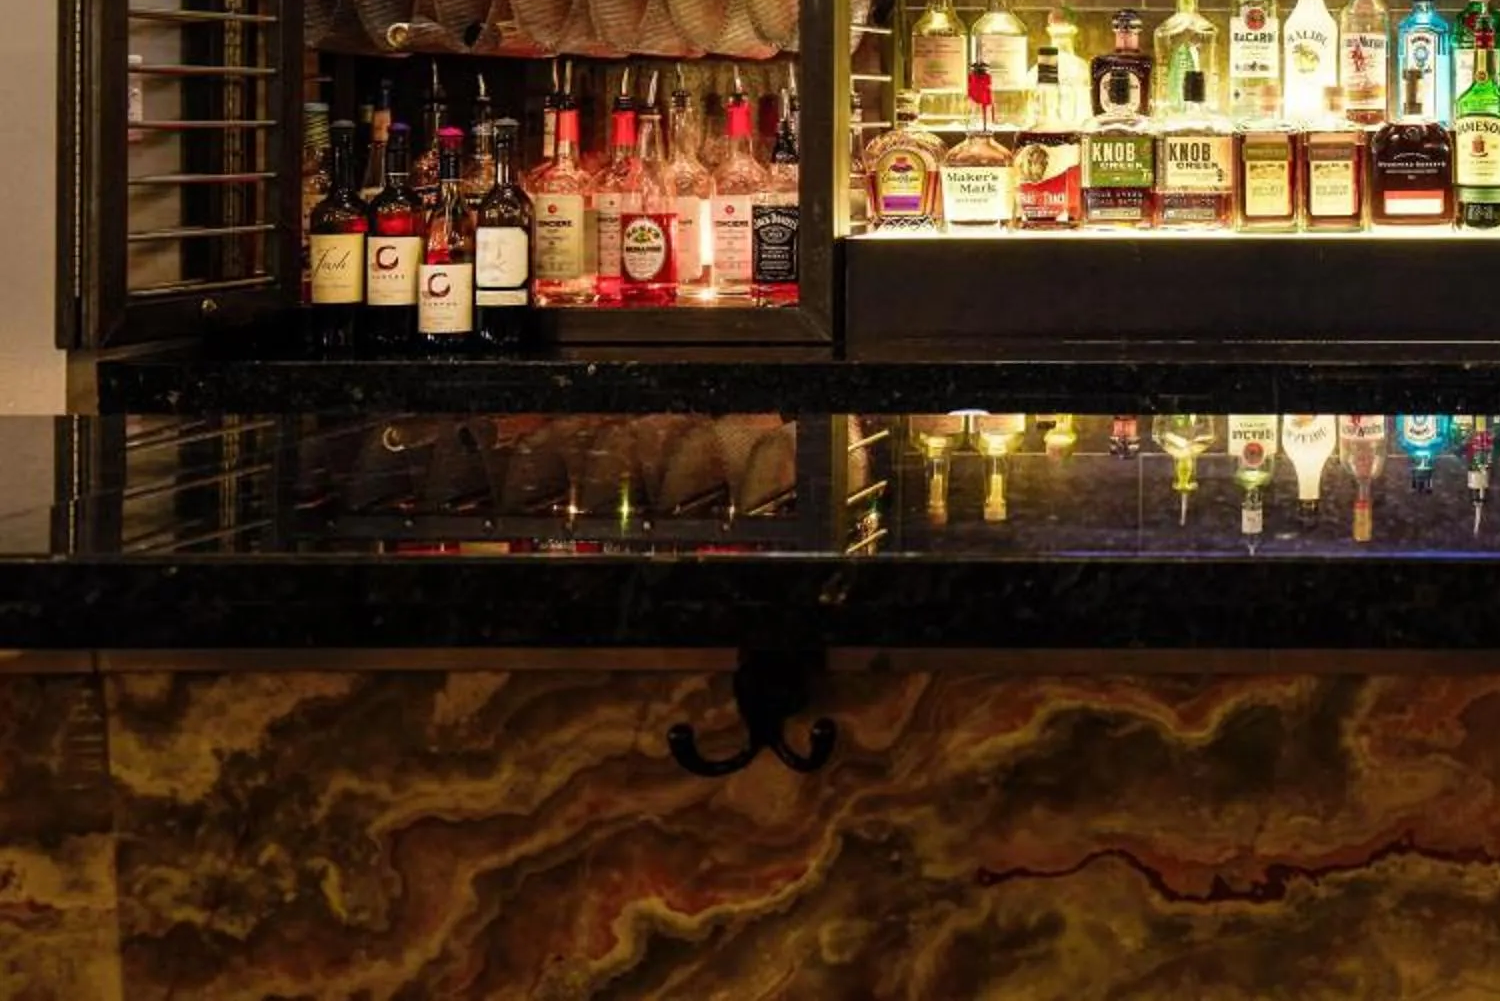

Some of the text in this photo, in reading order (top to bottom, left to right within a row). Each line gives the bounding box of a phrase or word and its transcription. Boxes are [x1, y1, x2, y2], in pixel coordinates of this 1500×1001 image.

[1091, 142, 1136, 161] KNOB
[1168, 142, 1211, 161] KNOB
[945, 171, 999, 182] Maker's
[959, 183, 997, 194] Mark
